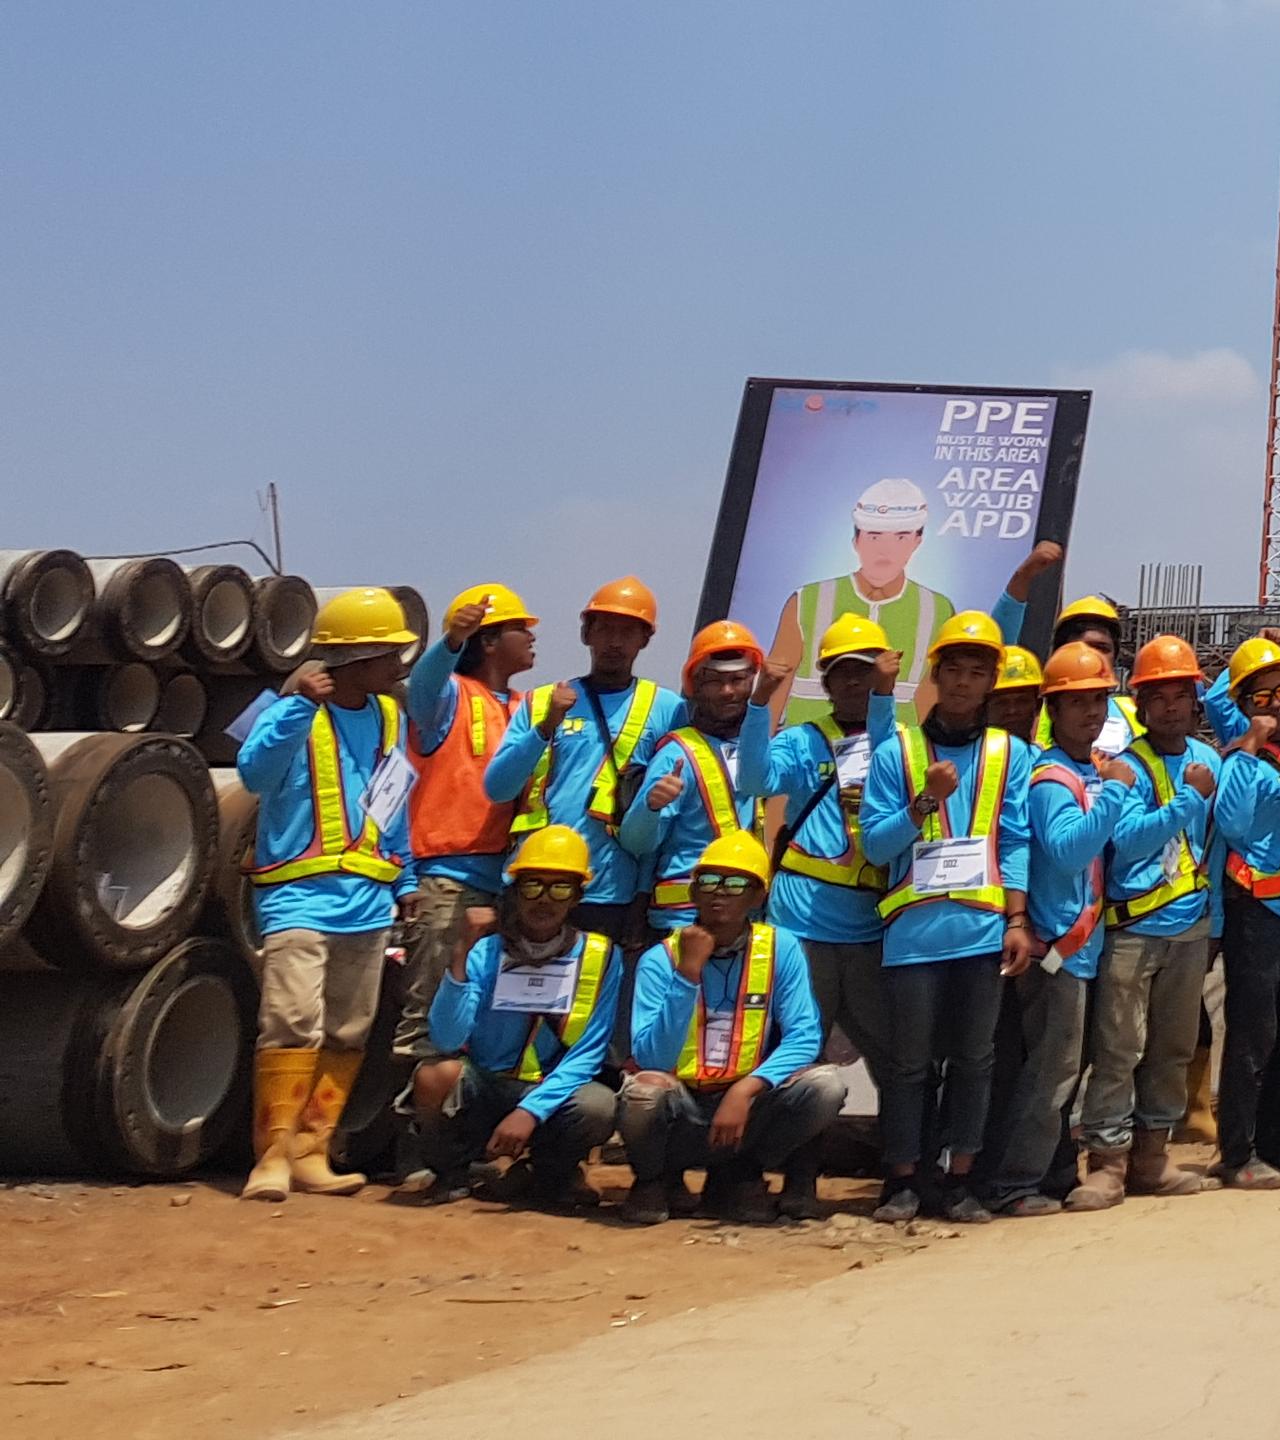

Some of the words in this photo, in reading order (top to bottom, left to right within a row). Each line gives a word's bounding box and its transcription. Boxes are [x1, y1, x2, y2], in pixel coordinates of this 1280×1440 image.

[940, 400, 1049, 435] PPE
[936, 435, 973, 445] MUST
[976, 436, 995, 446] BE
[998, 436, 1048, 448] WORN
[935, 446, 953, 460] IN
[958, 447, 993, 461] THIS
[993, 448, 1040, 464] AREA
[937, 467, 1040, 492] AREA
[943, 492, 1034, 510] WAJIB
[937, 510, 1031, 539] APD
